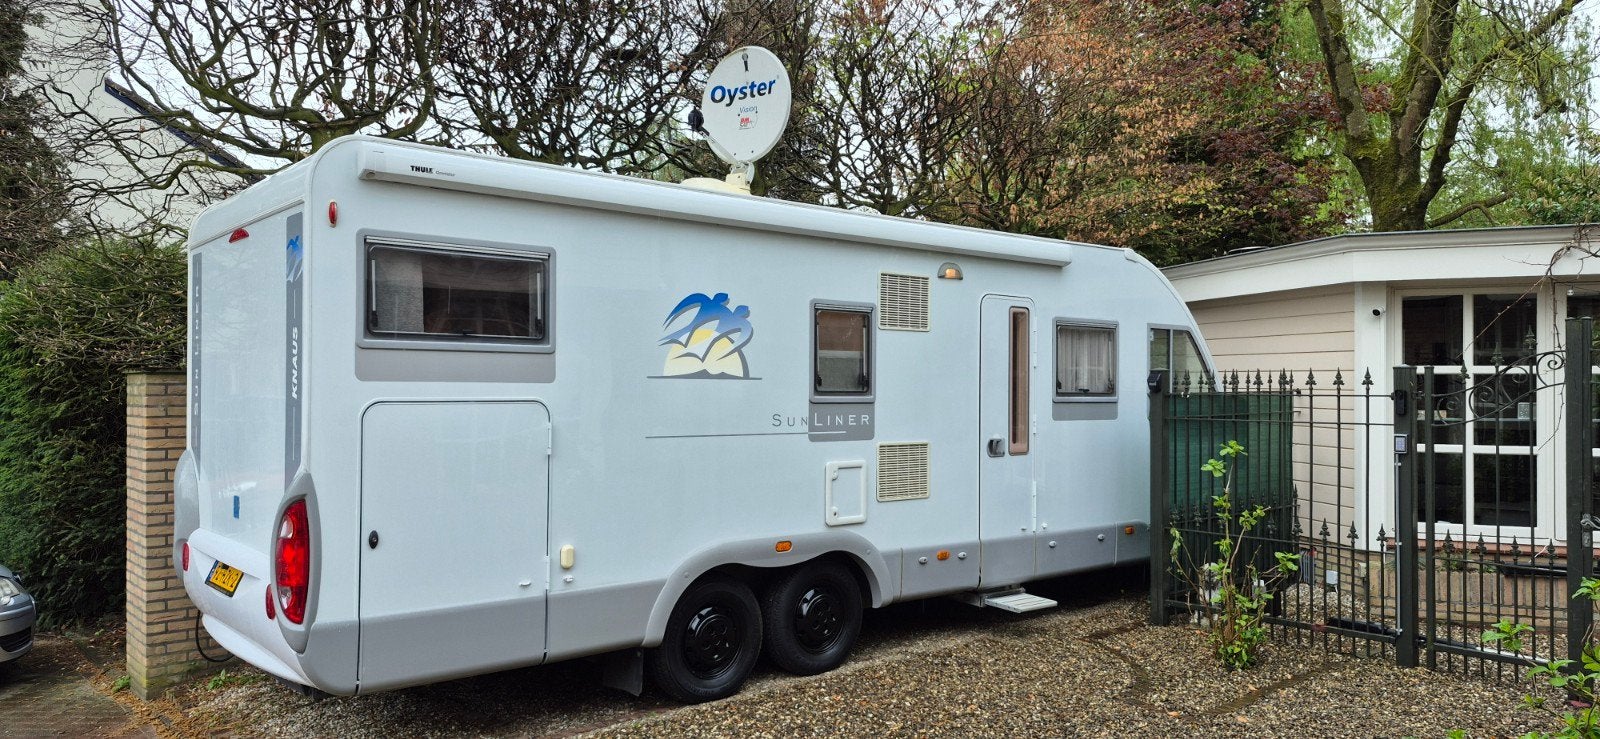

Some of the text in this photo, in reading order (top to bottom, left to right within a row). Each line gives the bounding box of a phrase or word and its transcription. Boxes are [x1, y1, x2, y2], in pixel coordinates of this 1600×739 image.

[710, 79, 776, 107] Oyster
[410, 165, 433, 174] THULE
[291, 326, 299, 400] KNAUS
